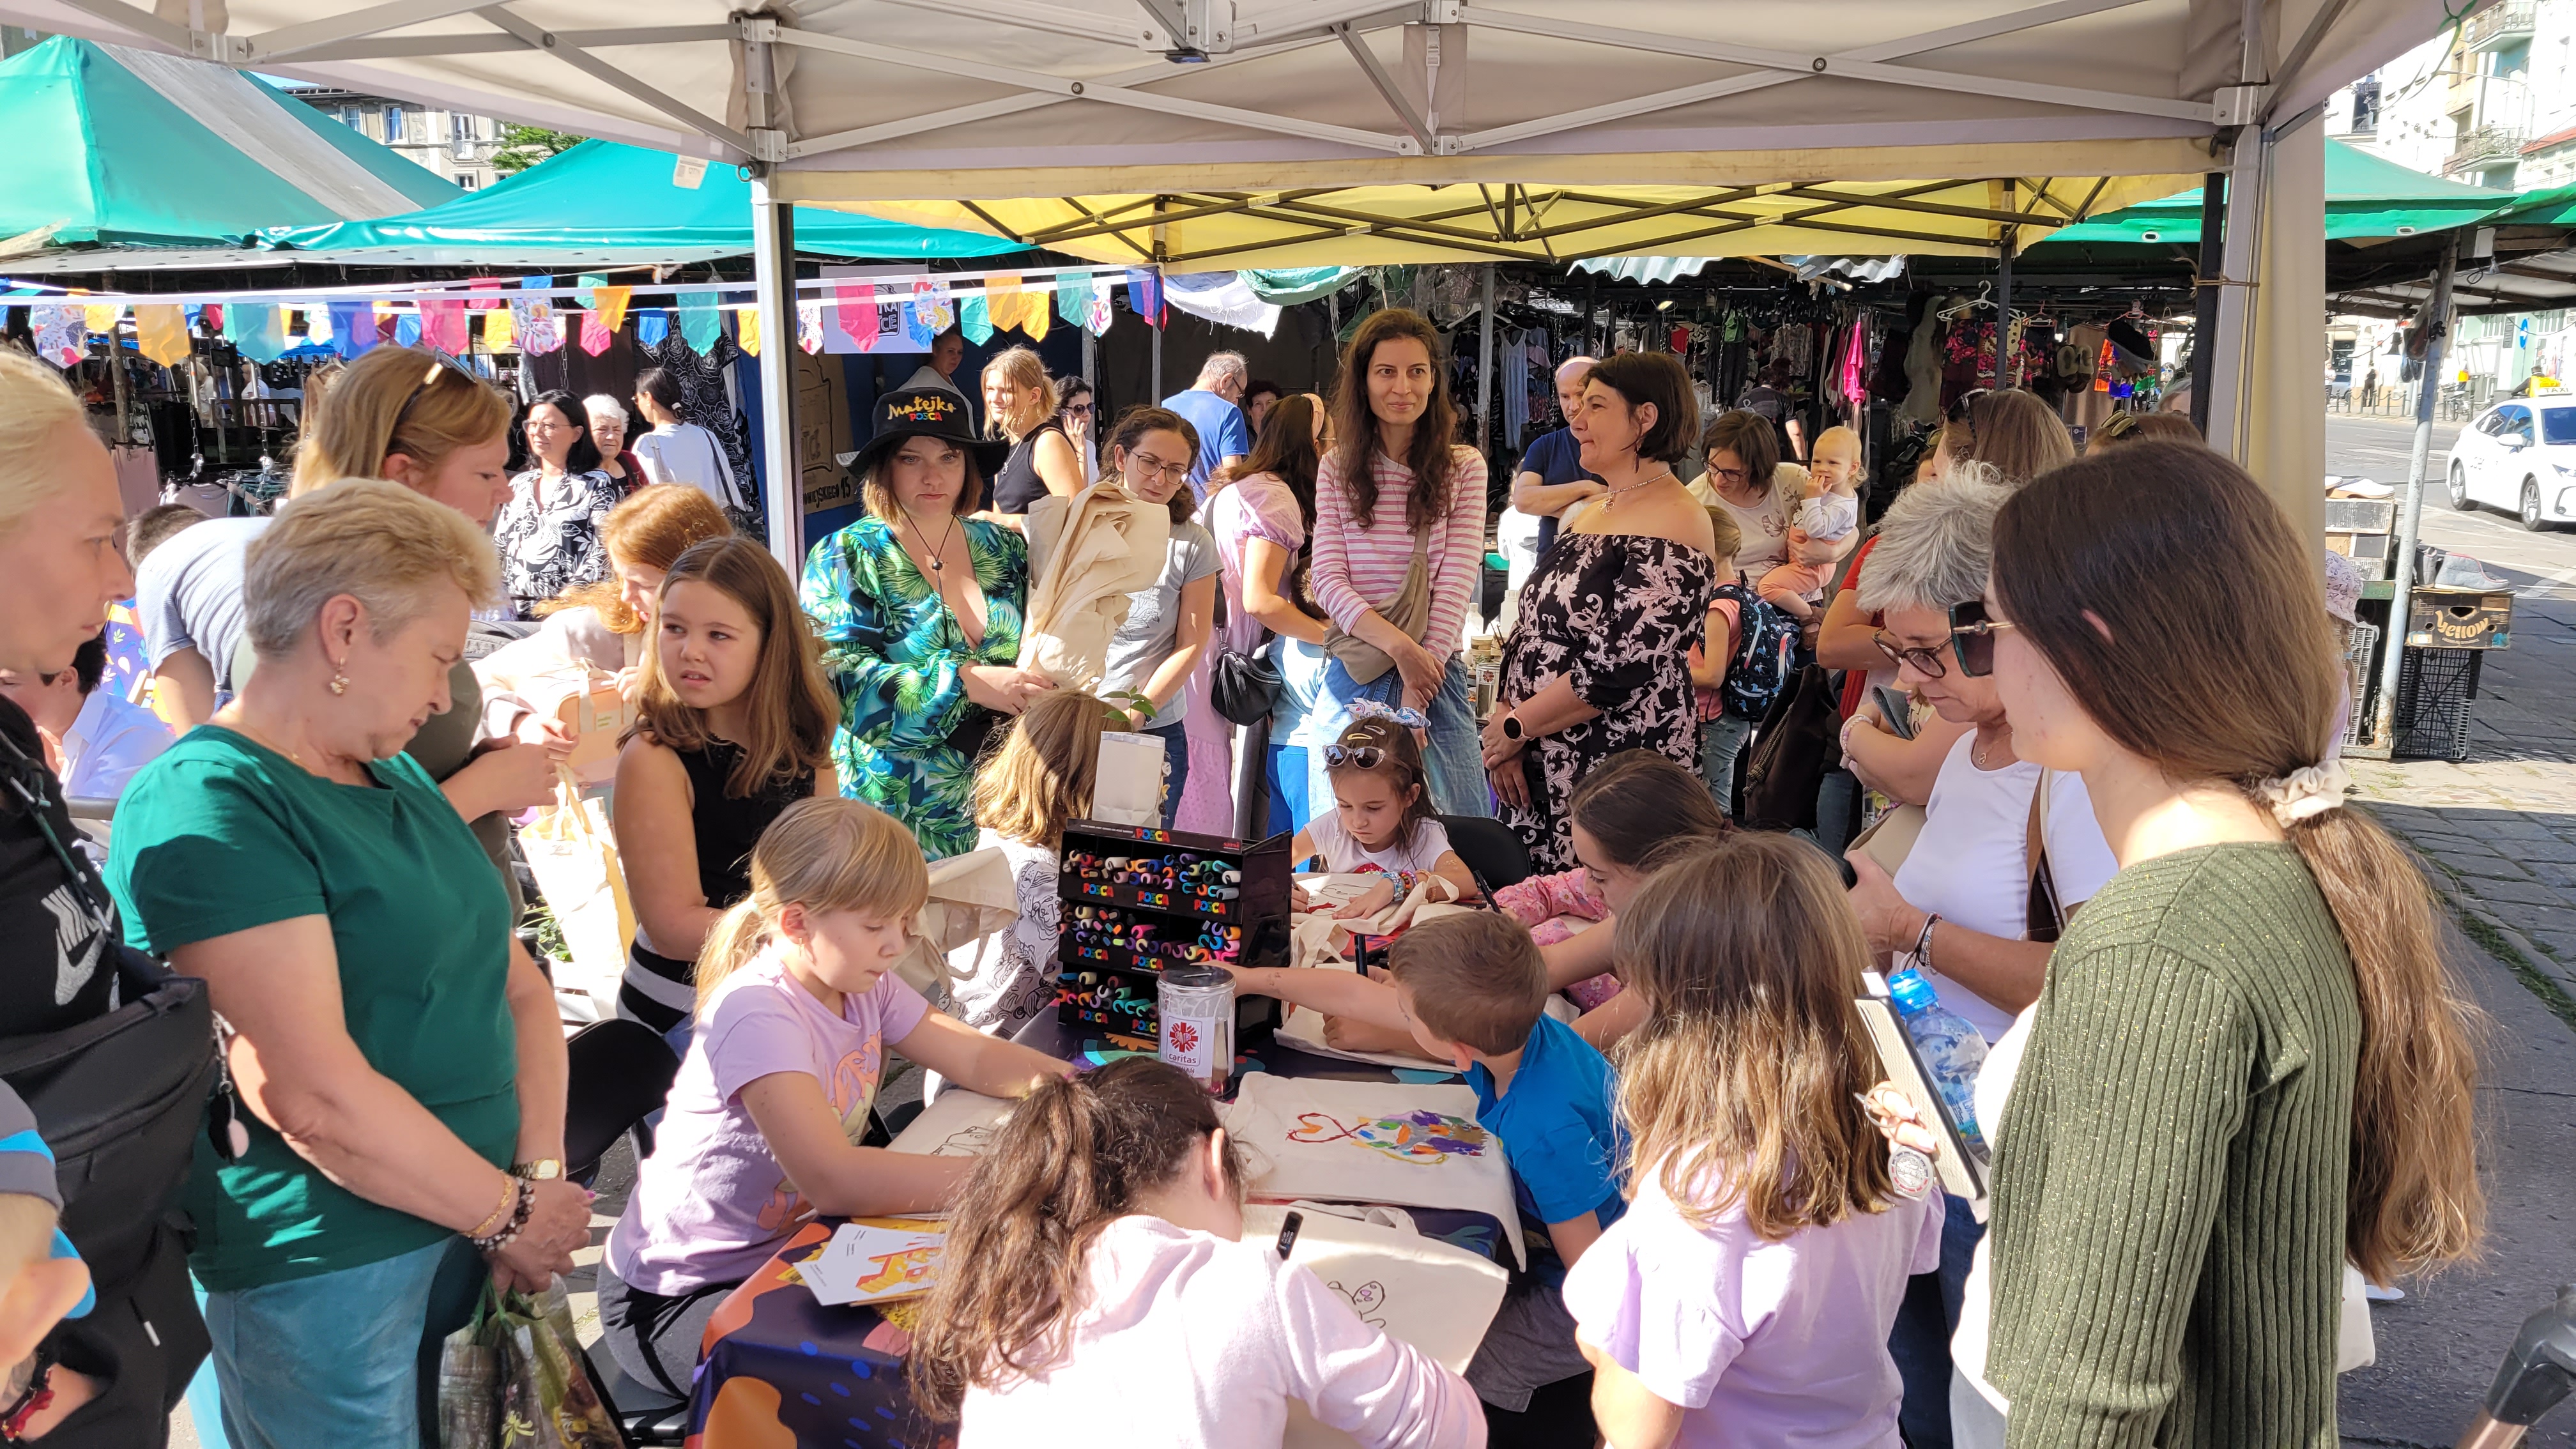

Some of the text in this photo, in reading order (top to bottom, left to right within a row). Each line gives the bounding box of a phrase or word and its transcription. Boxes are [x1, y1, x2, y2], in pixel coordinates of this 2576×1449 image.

[908, 412, 943, 422] POSCA
[841, 476, 851, 499] 15
[1135, 827, 1170, 843] POSCA
[1083, 882, 1114, 898] POSCA
[1137, 891, 1169, 906] POSCA
[1193, 899, 1227, 915] POSCA
[1078, 946, 1108, 961] POSCA
[1131, 954, 1164, 970] POSCA
[1078, 1009, 1108, 1024] POSCA
[1131, 1018, 1159, 1033] POSC
[1169, 1053, 1197, 1064] caritas
